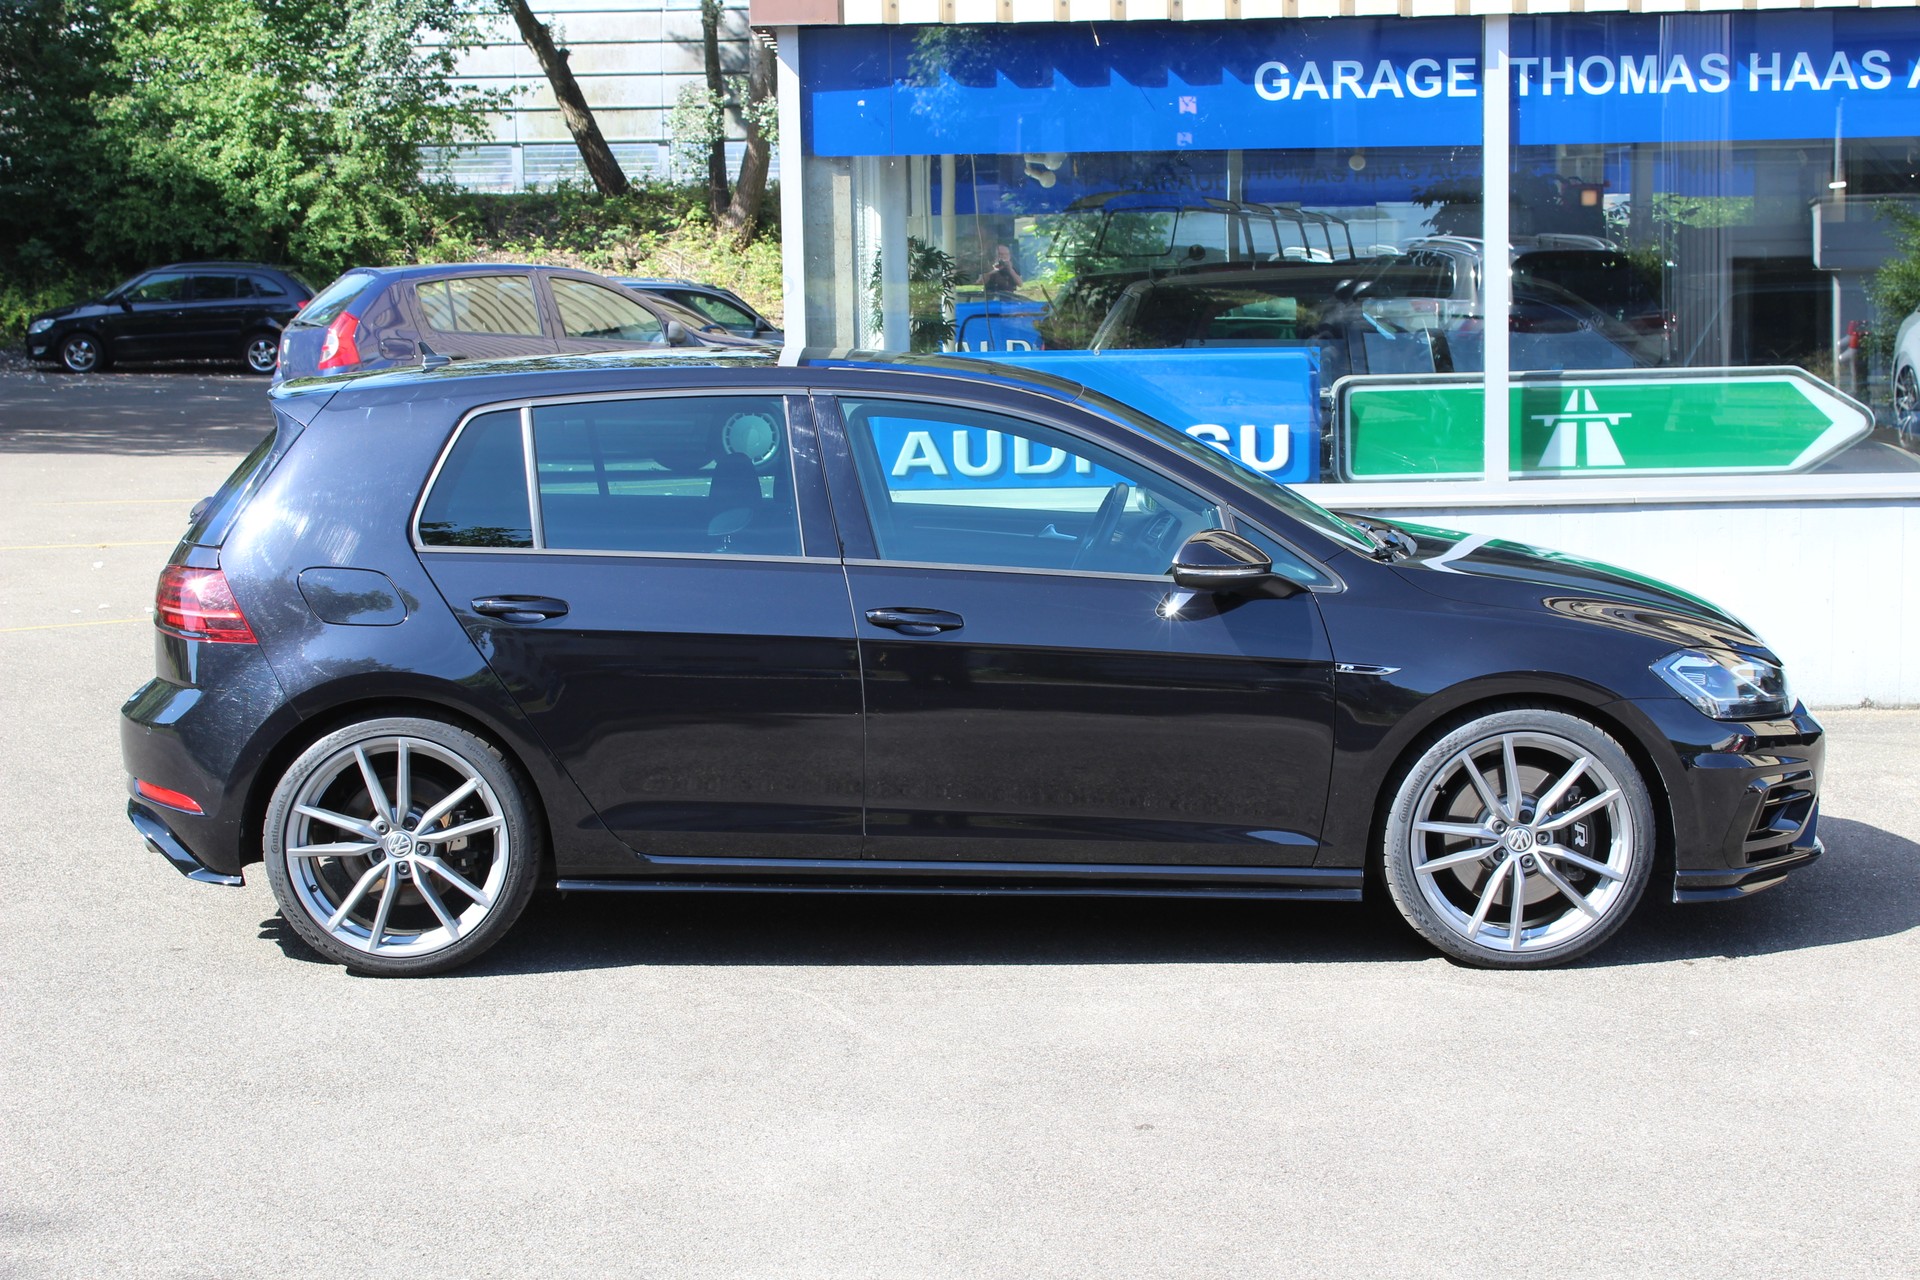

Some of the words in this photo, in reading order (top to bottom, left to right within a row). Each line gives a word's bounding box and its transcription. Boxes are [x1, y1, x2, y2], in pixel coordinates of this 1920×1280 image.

[1255, 59, 1477, 101] GARAGE
[1511, 54, 1731, 96] THOMAS
[1750, 51, 1892, 91] HAAS
[1399, 770, 1427, 823] Continental
[271, 799, 286, 854] Continental
